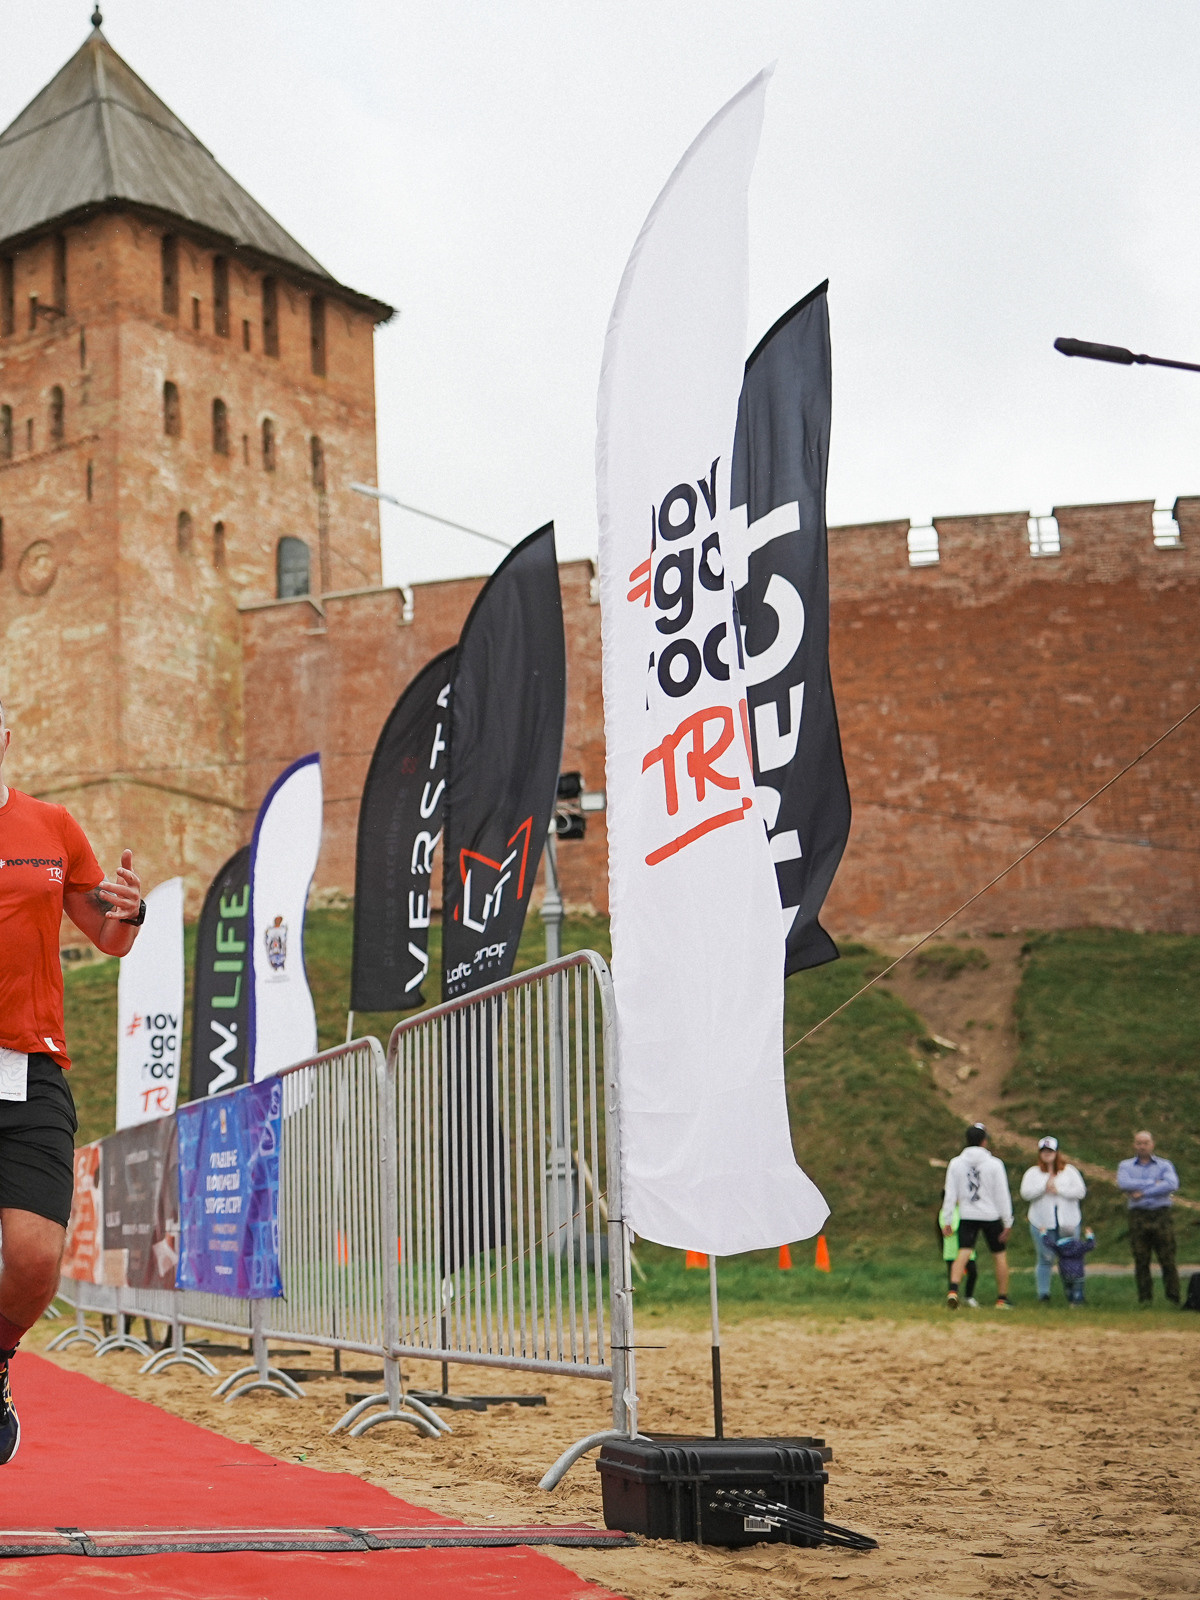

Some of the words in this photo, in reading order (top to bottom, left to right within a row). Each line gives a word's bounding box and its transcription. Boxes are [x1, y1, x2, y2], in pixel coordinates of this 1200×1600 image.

[211, 884, 251, 1009] LIFE
[446, 962, 472, 984] Loft
[141, 1086, 170, 1112] TR
